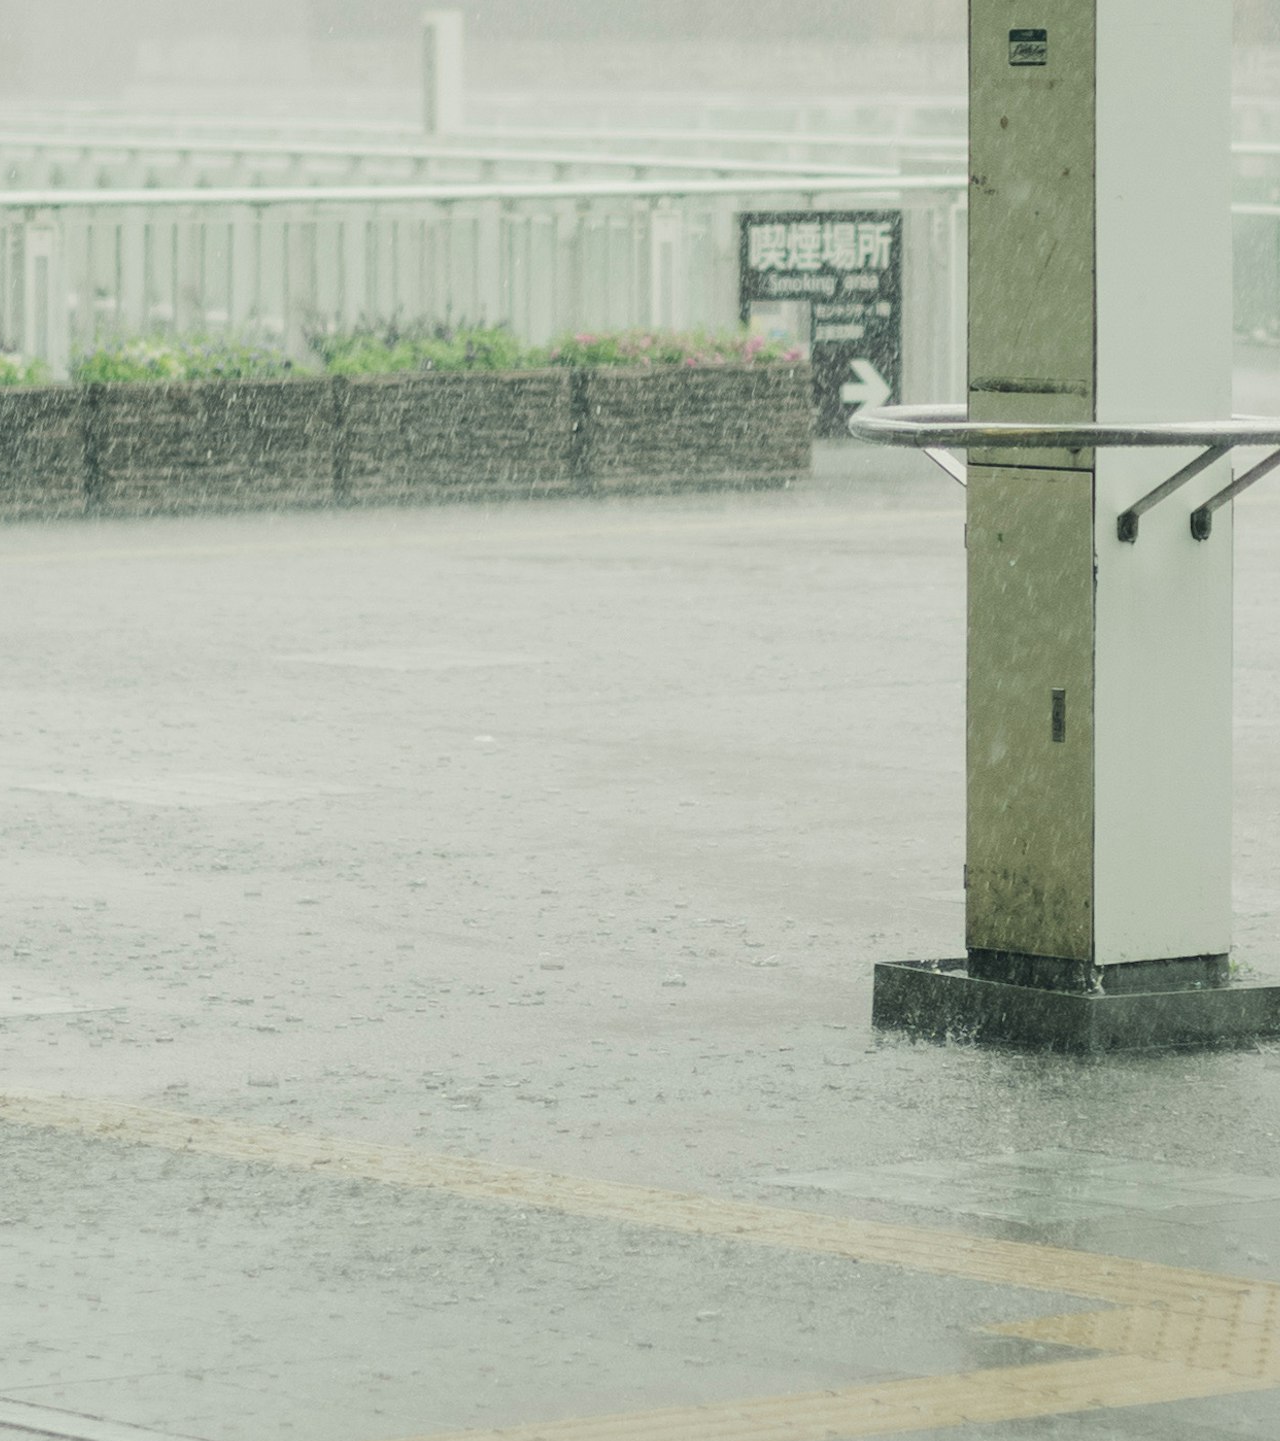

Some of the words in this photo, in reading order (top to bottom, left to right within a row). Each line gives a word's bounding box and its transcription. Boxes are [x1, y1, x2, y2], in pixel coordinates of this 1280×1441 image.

[748, 222, 893, 271] 喫煙場所
[769, 274, 836, 296] Smoking
[842, 275, 880, 290] area
